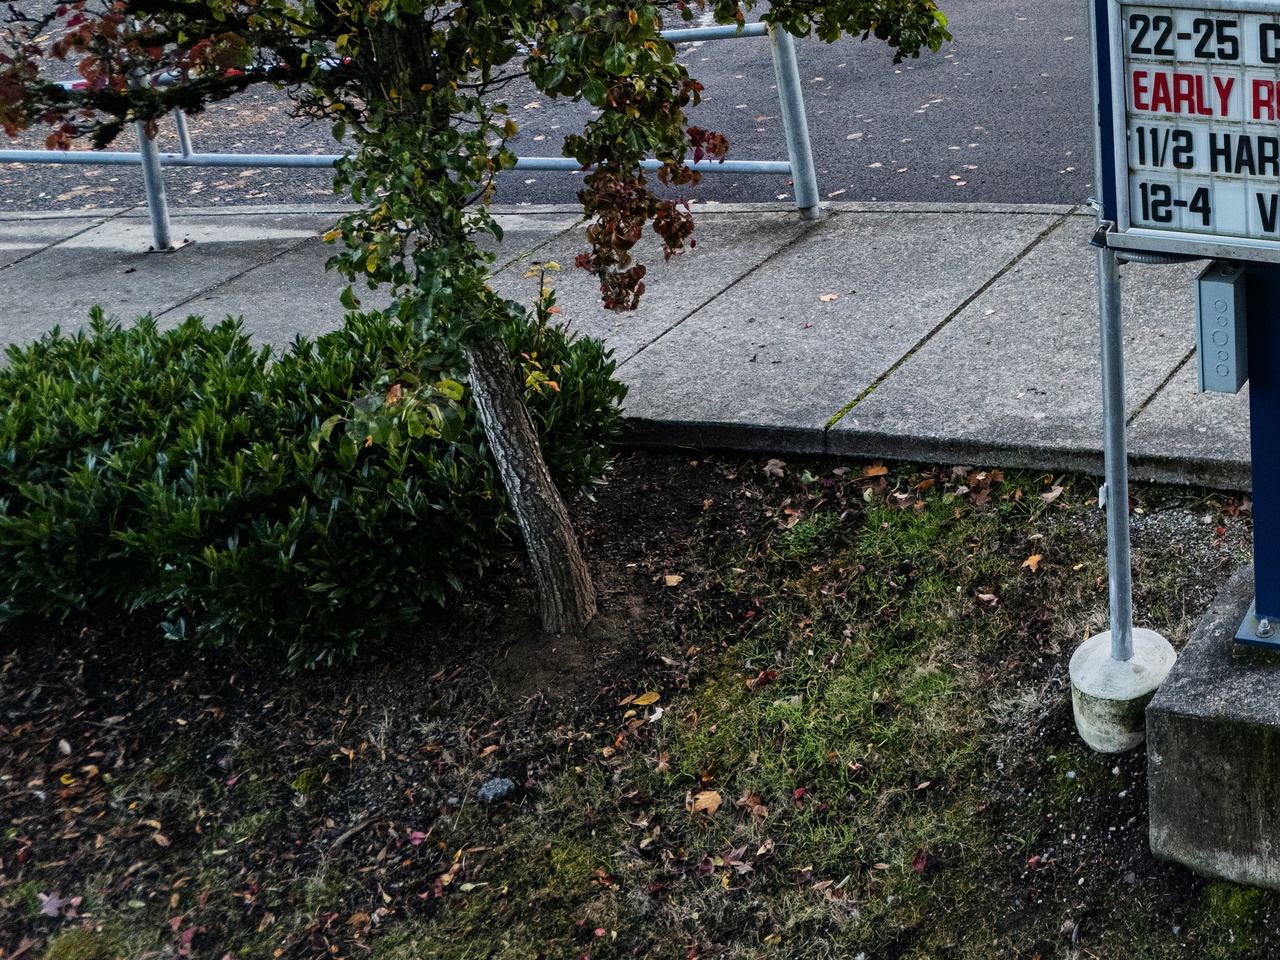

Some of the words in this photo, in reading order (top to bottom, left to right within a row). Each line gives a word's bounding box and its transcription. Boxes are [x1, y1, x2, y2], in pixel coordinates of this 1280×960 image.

[1130, 14, 1239, 60] 22-25
[1133, 71, 1235, 117] EARLY
[1136, 126, 1194, 170] 11/2
[1139, 182, 1211, 226] 12-4
